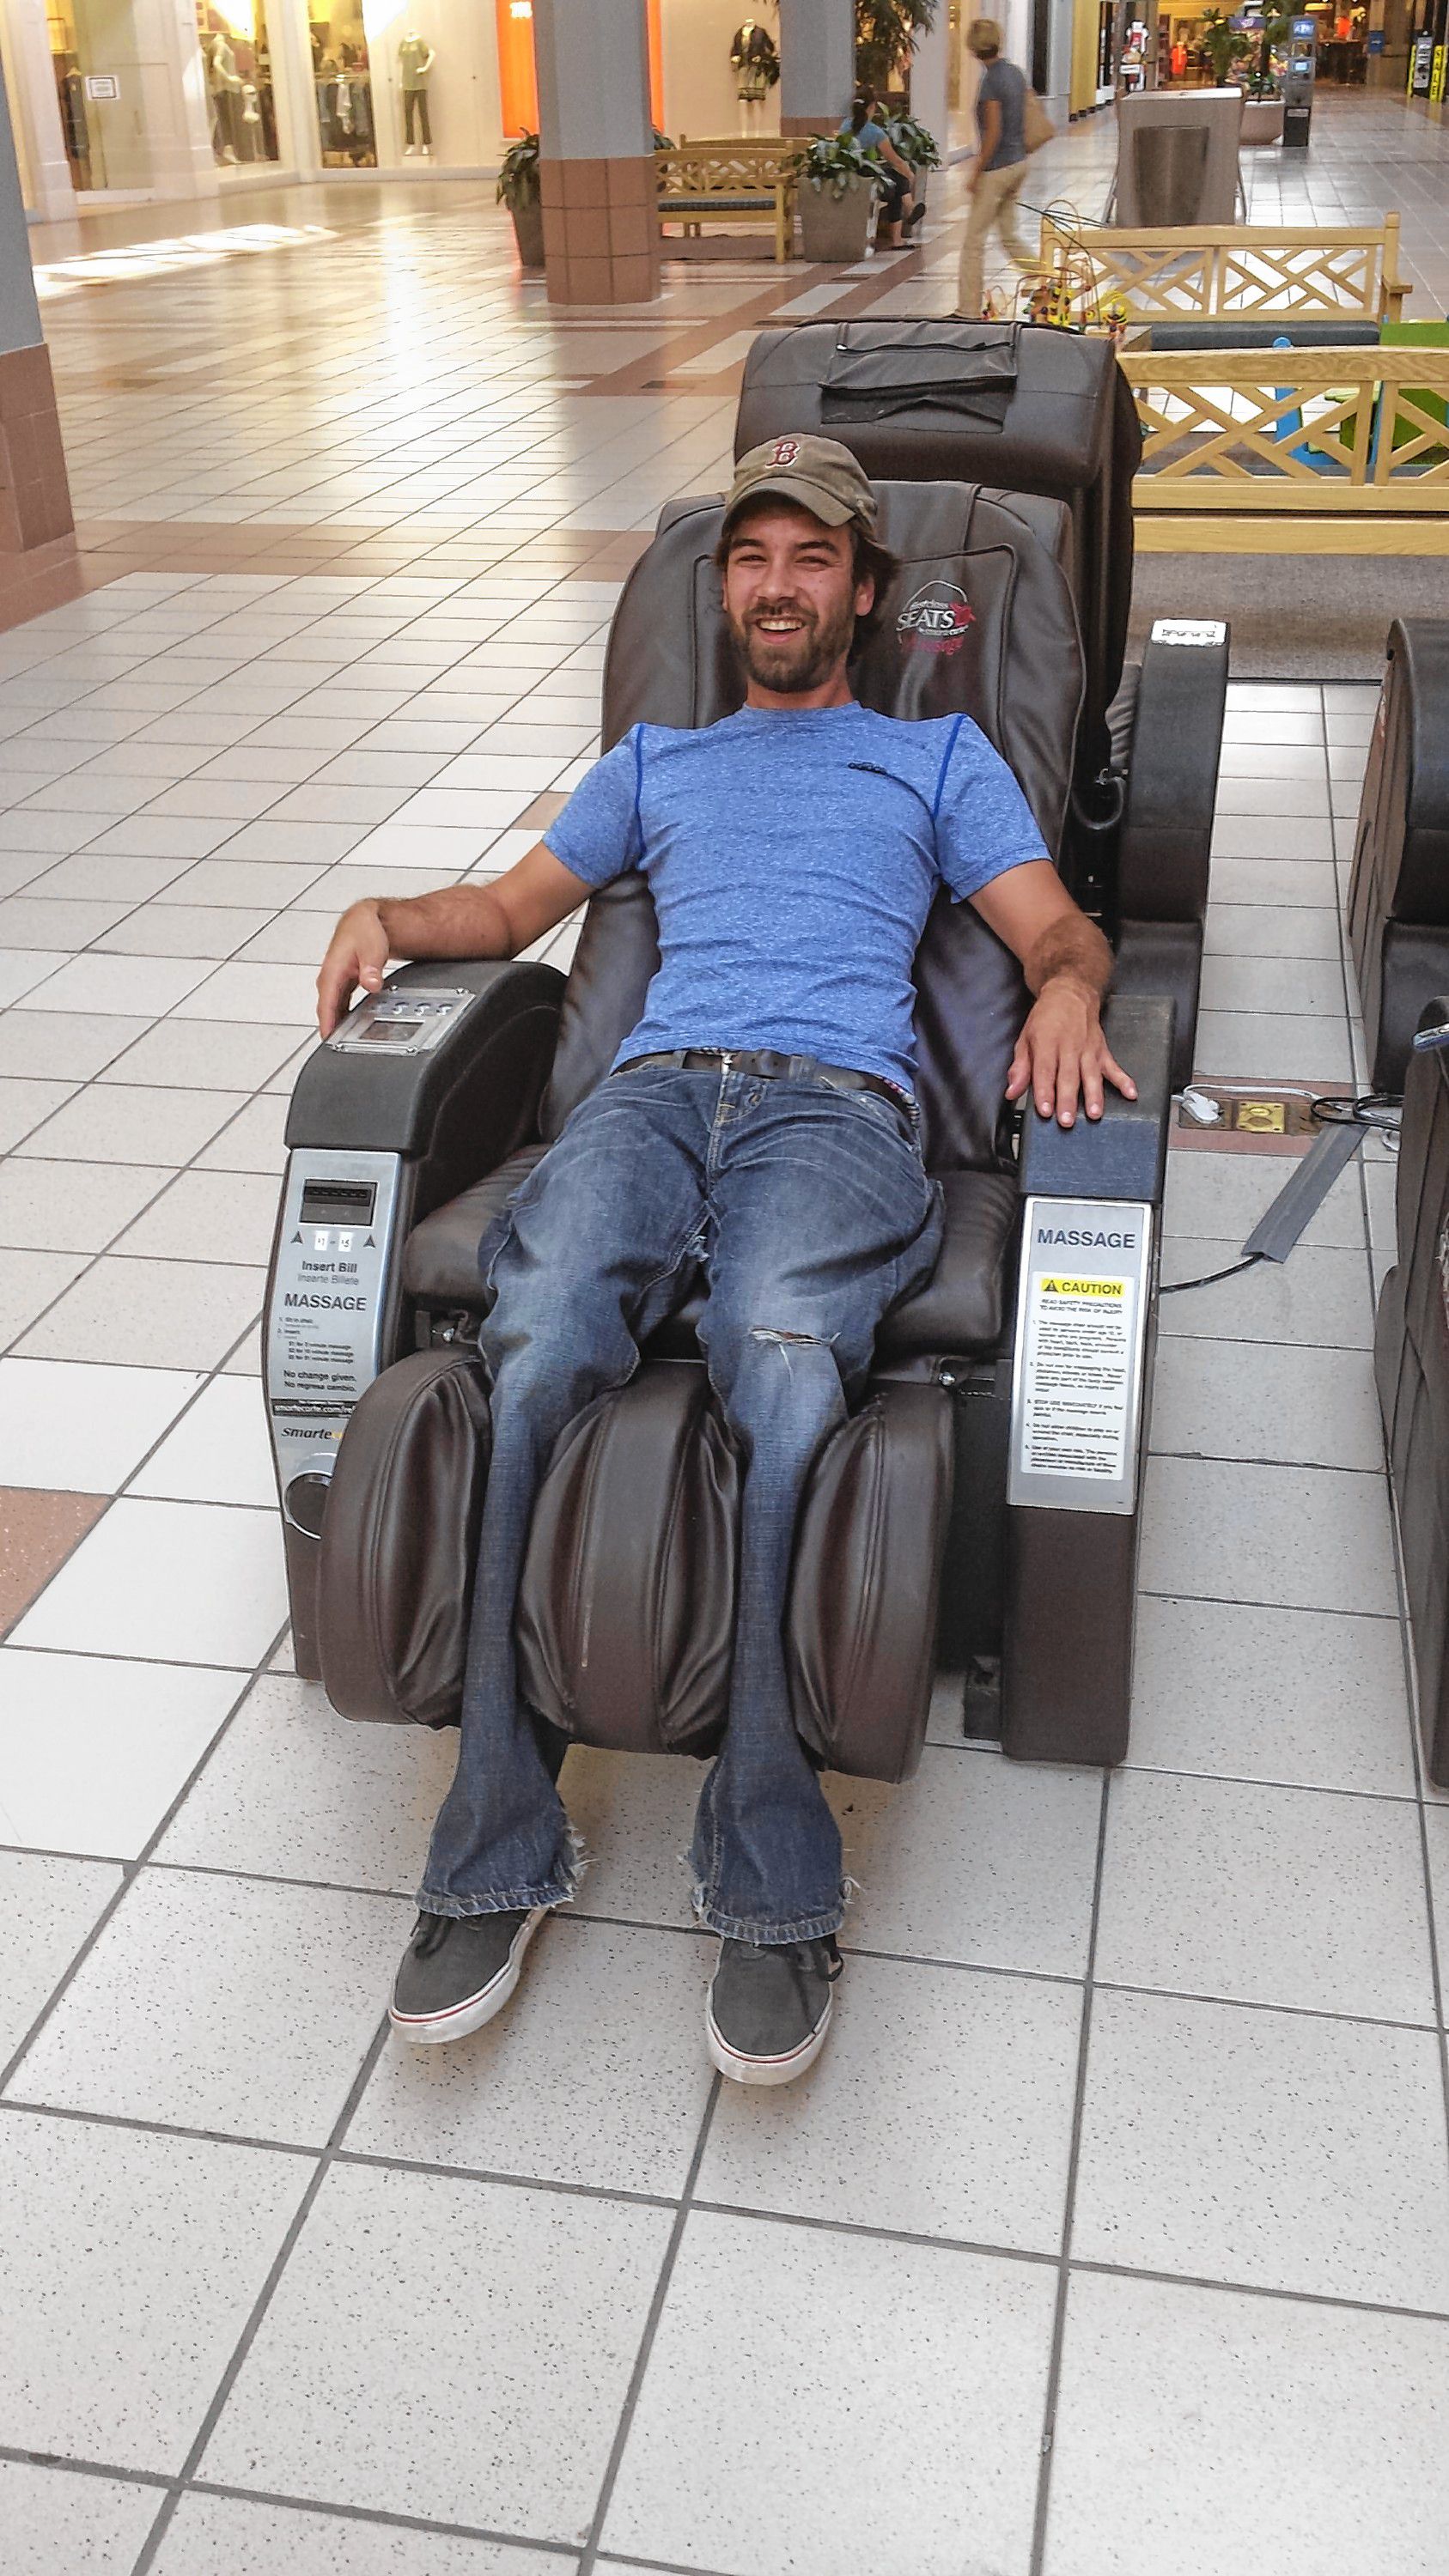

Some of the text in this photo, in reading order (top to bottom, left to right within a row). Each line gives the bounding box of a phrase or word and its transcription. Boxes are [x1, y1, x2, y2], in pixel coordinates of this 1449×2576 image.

[765, 440, 801, 468] B
[896, 609, 956, 632] SEATS
[1038, 1229, 1135, 1249] MASSAGE
[302, 1261, 357, 1273] Insert Bill
[1062, 1281, 1122, 1295] CAUTION
[284, 1292, 368, 1311] MASSAGE
[283, 1369, 295, 1378] No
[298, 1371, 329, 1382] change
[283, 1380, 295, 1388] No
